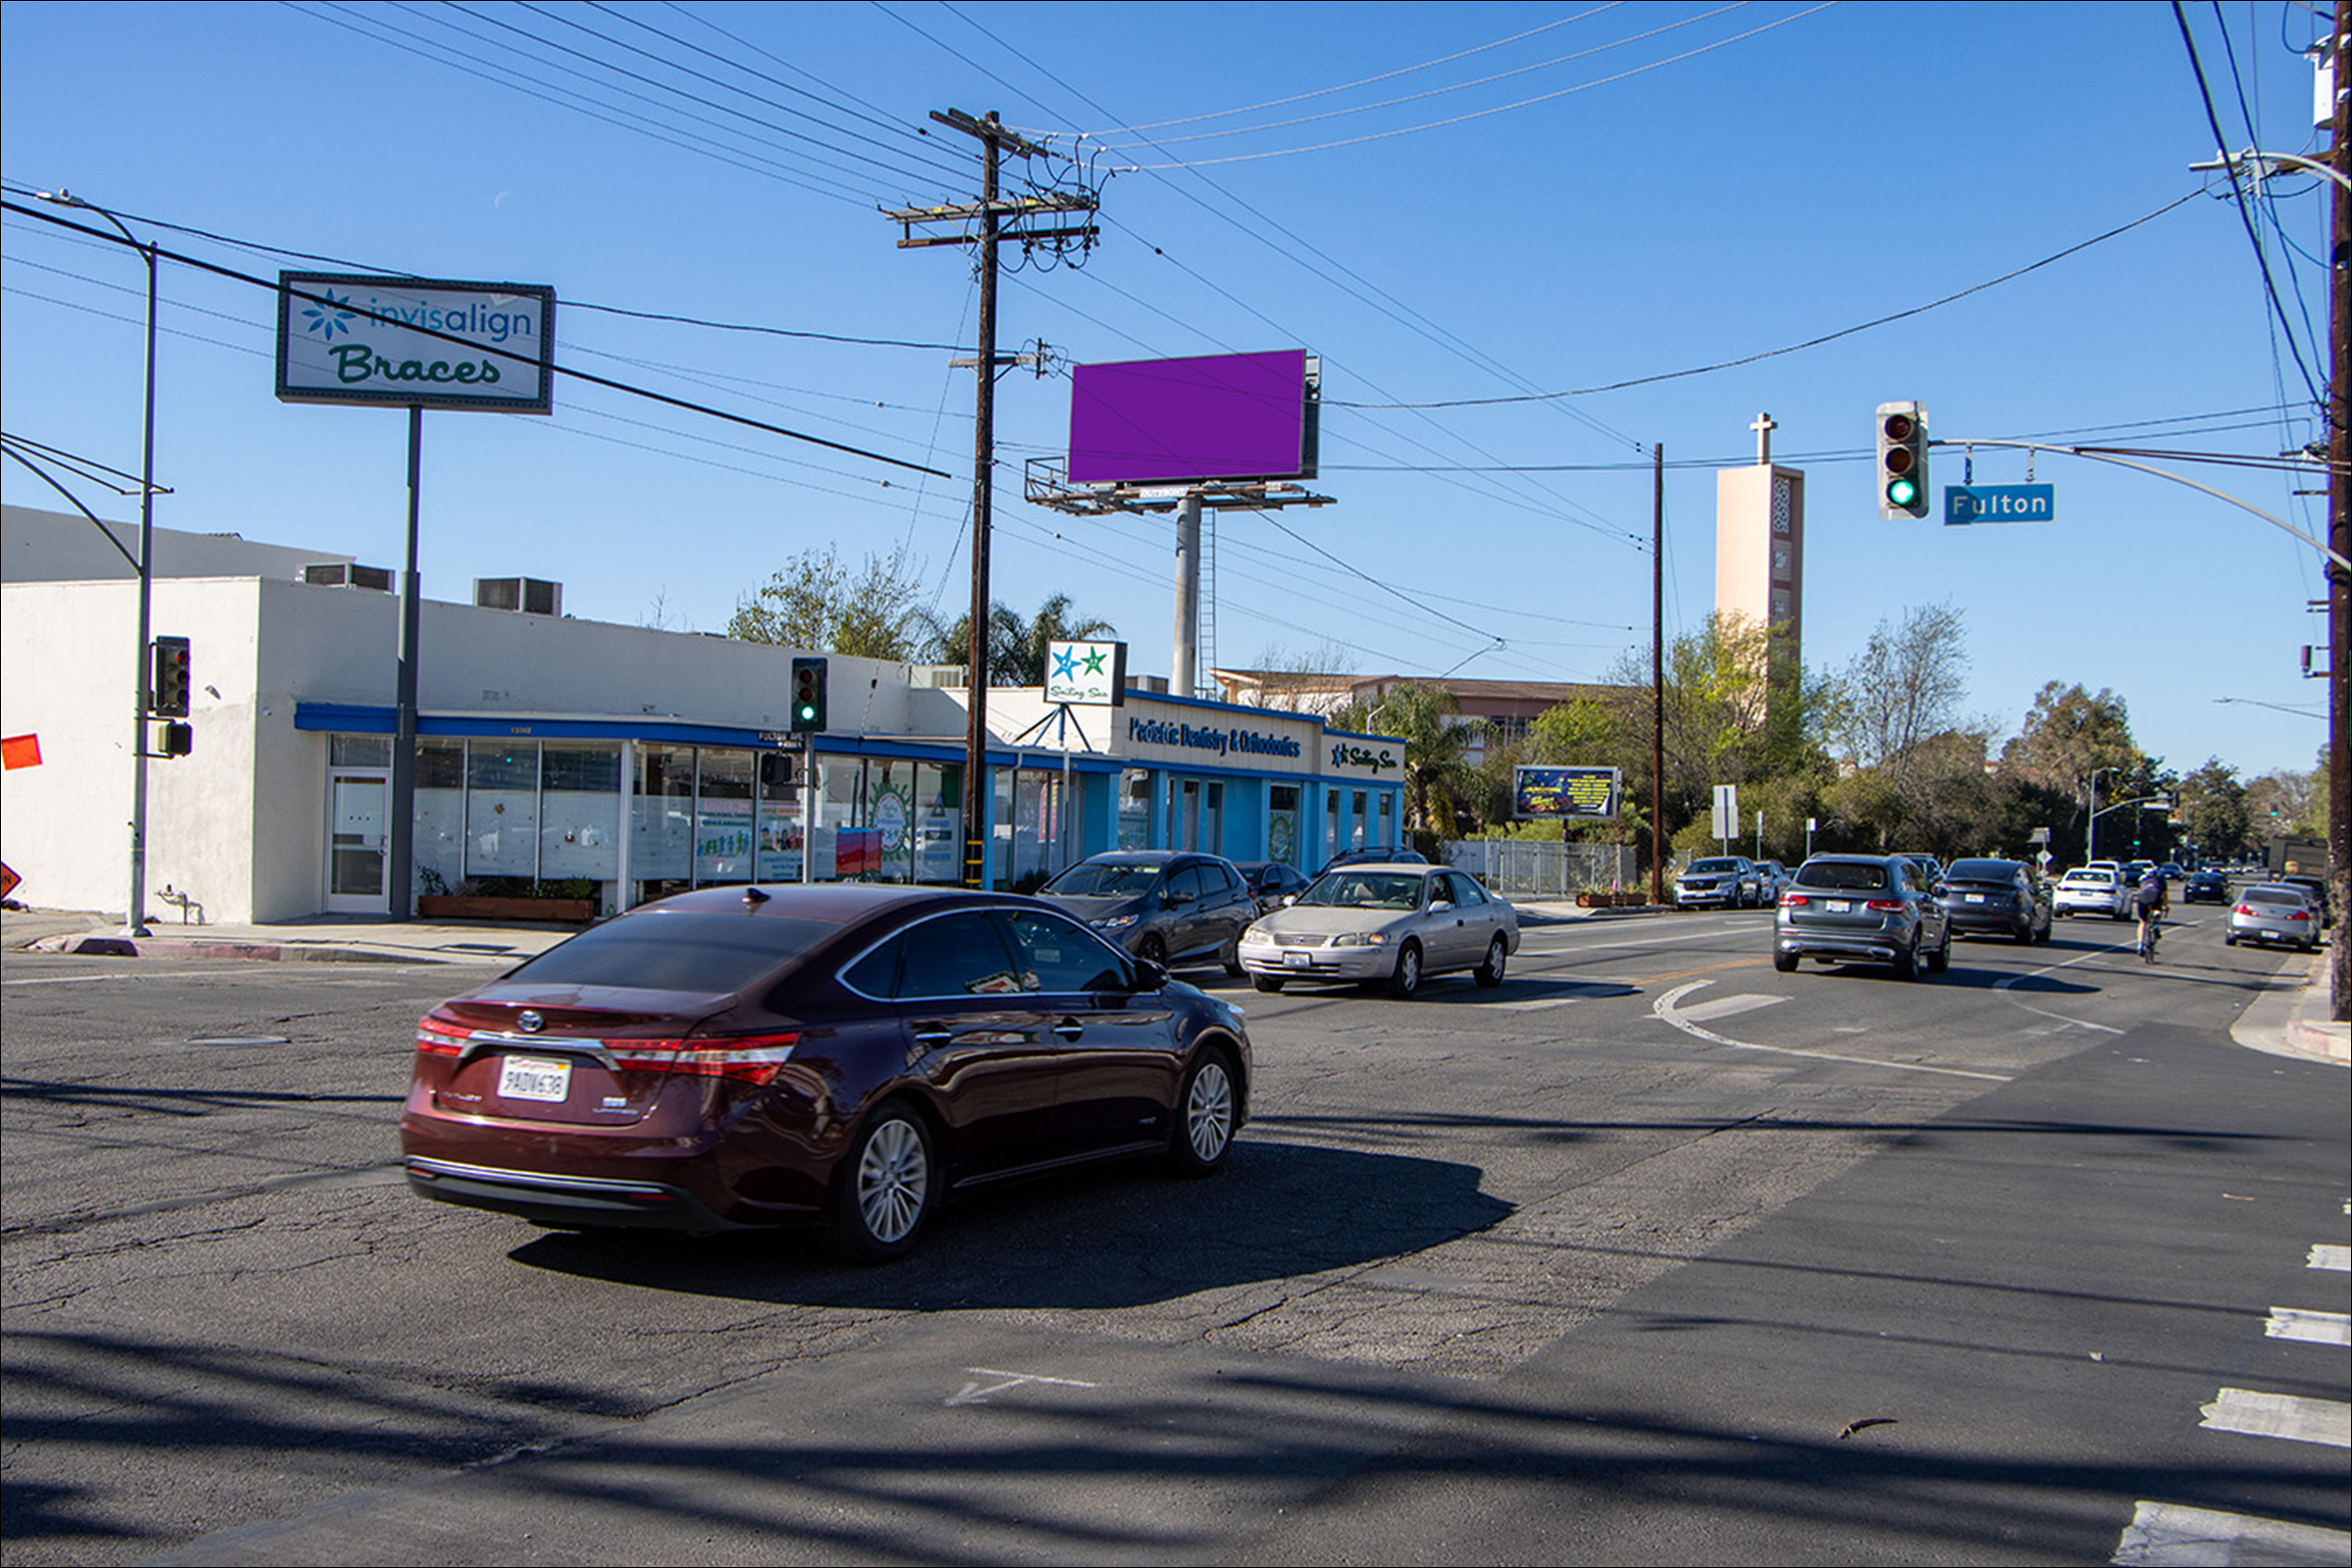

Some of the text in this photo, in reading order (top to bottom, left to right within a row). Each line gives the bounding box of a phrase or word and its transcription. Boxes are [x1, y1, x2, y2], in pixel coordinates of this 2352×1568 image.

[369, 297, 531, 342] invisalign
[328, 344, 501, 384] Braces
[1953, 494, 2046, 515] Fulton
[1129, 716, 1301, 758] Pediatric Dentistry & Orthodontics
